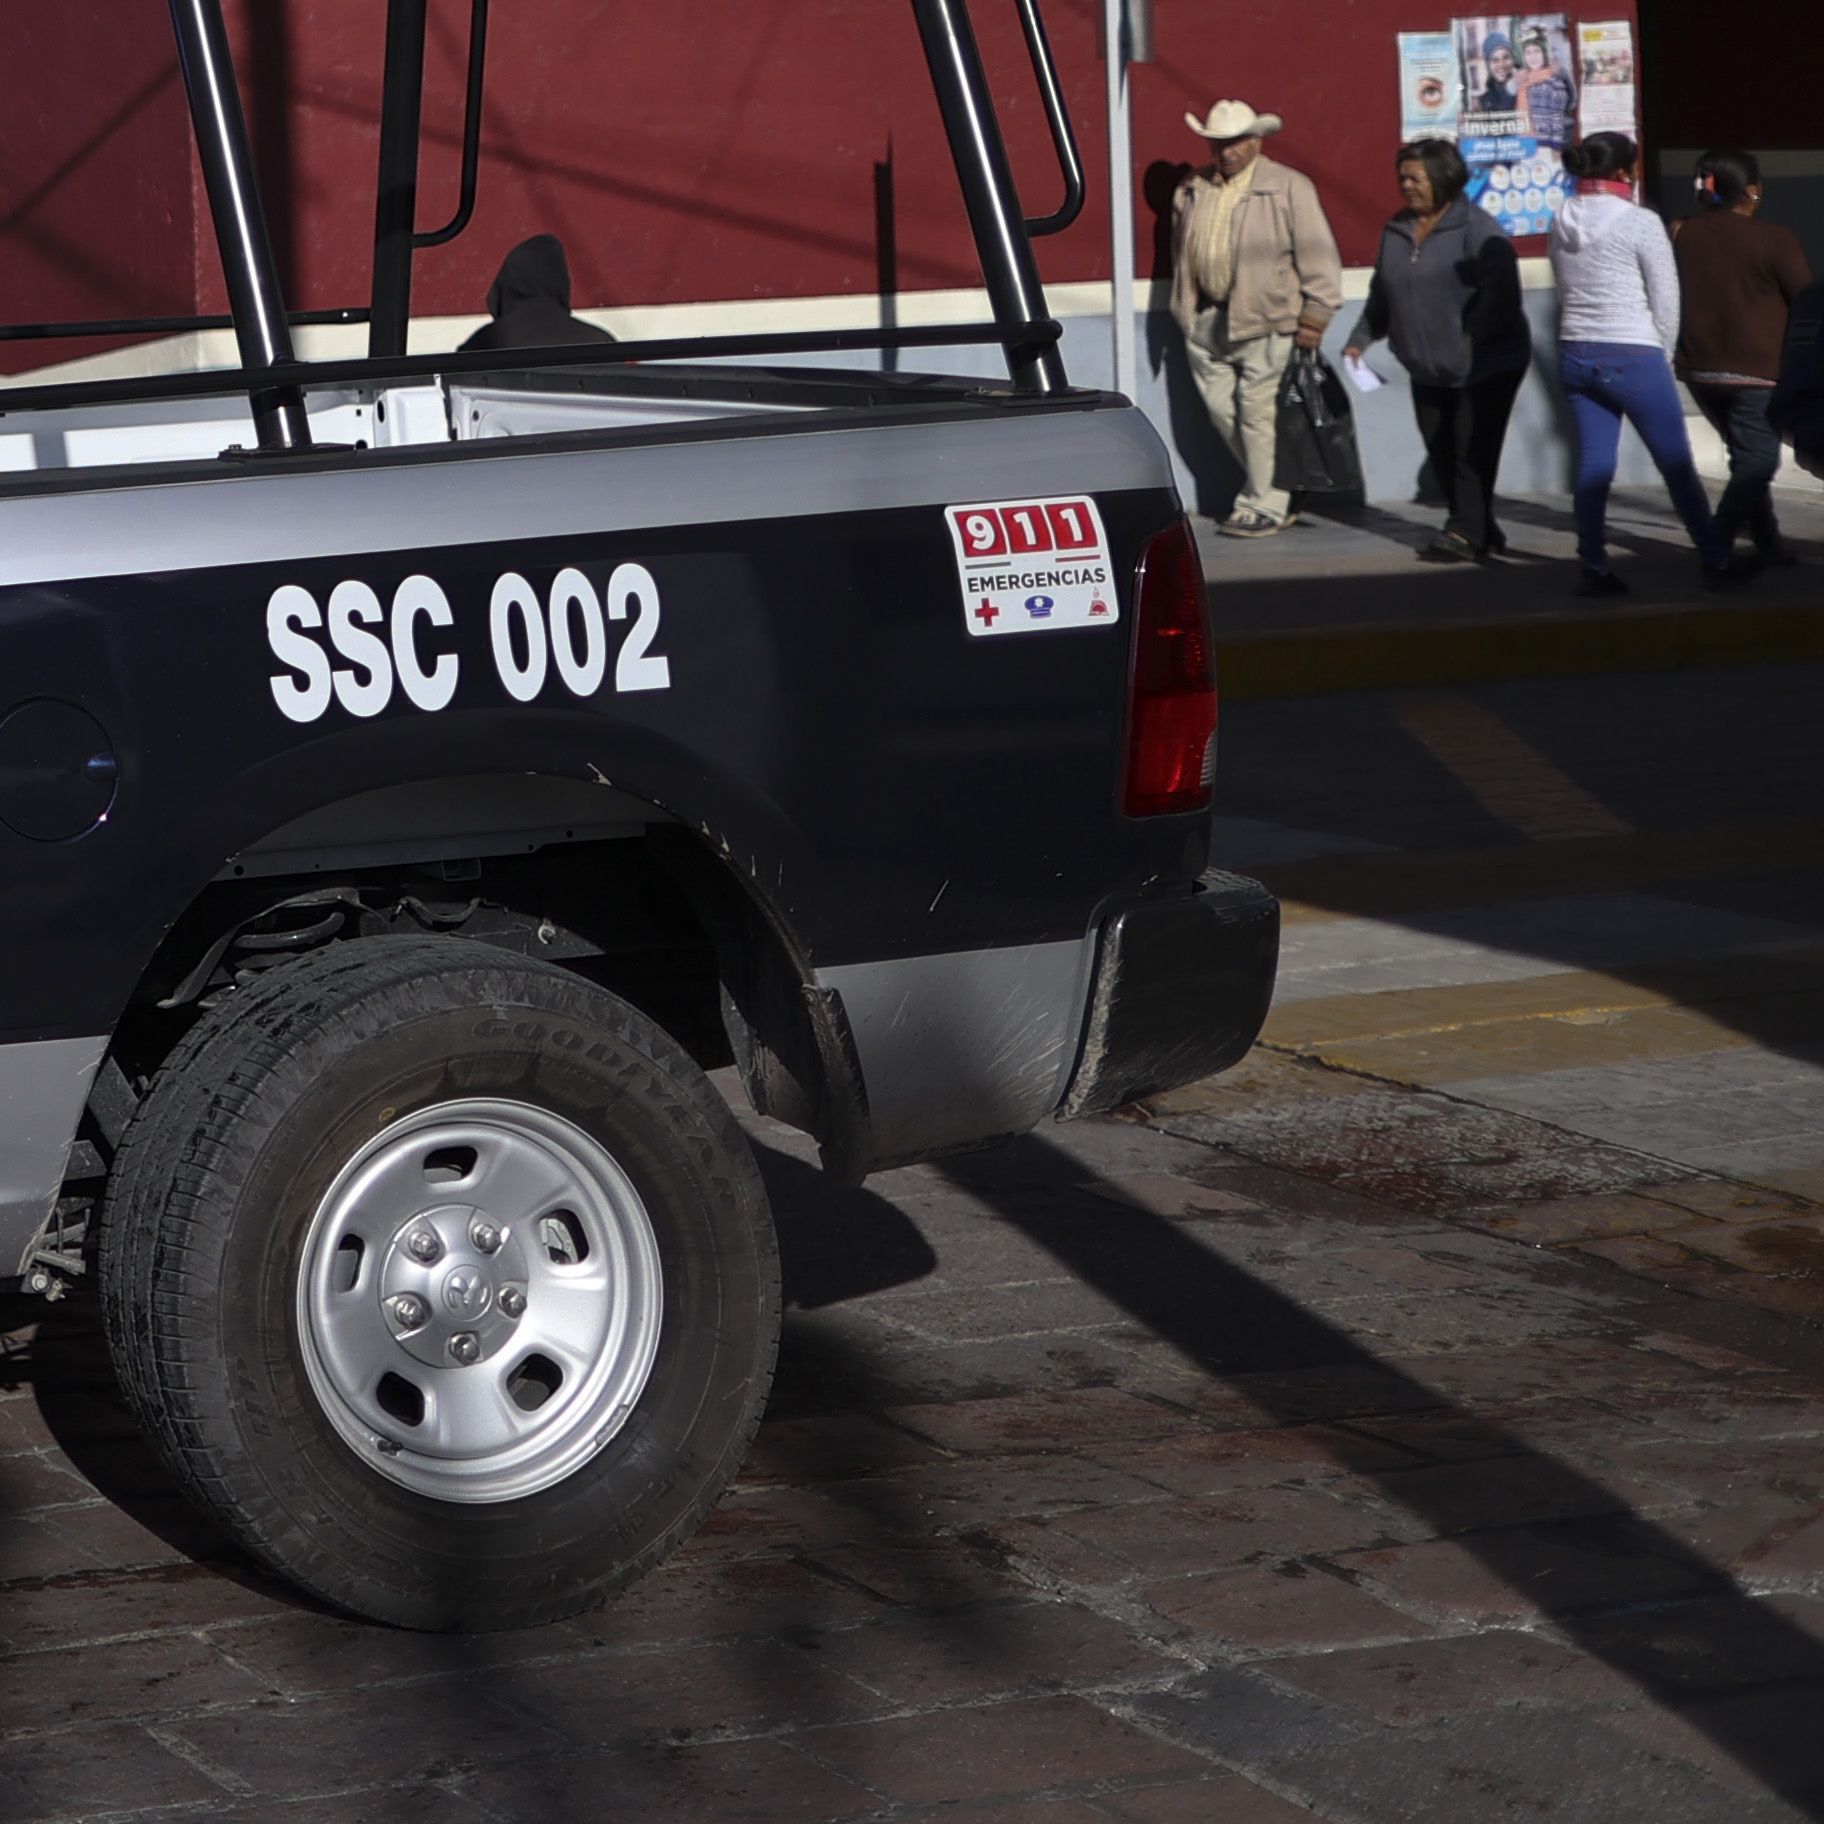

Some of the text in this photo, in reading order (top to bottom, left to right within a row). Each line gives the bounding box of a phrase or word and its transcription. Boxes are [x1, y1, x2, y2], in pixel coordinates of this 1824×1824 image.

[964, 507, 1094, 555] 911
[966, 566, 1107, 594] EMERGENCIAS
[266, 562, 672, 723] SSC 002
[472, 1017, 737, 1212] GOODYEAR
